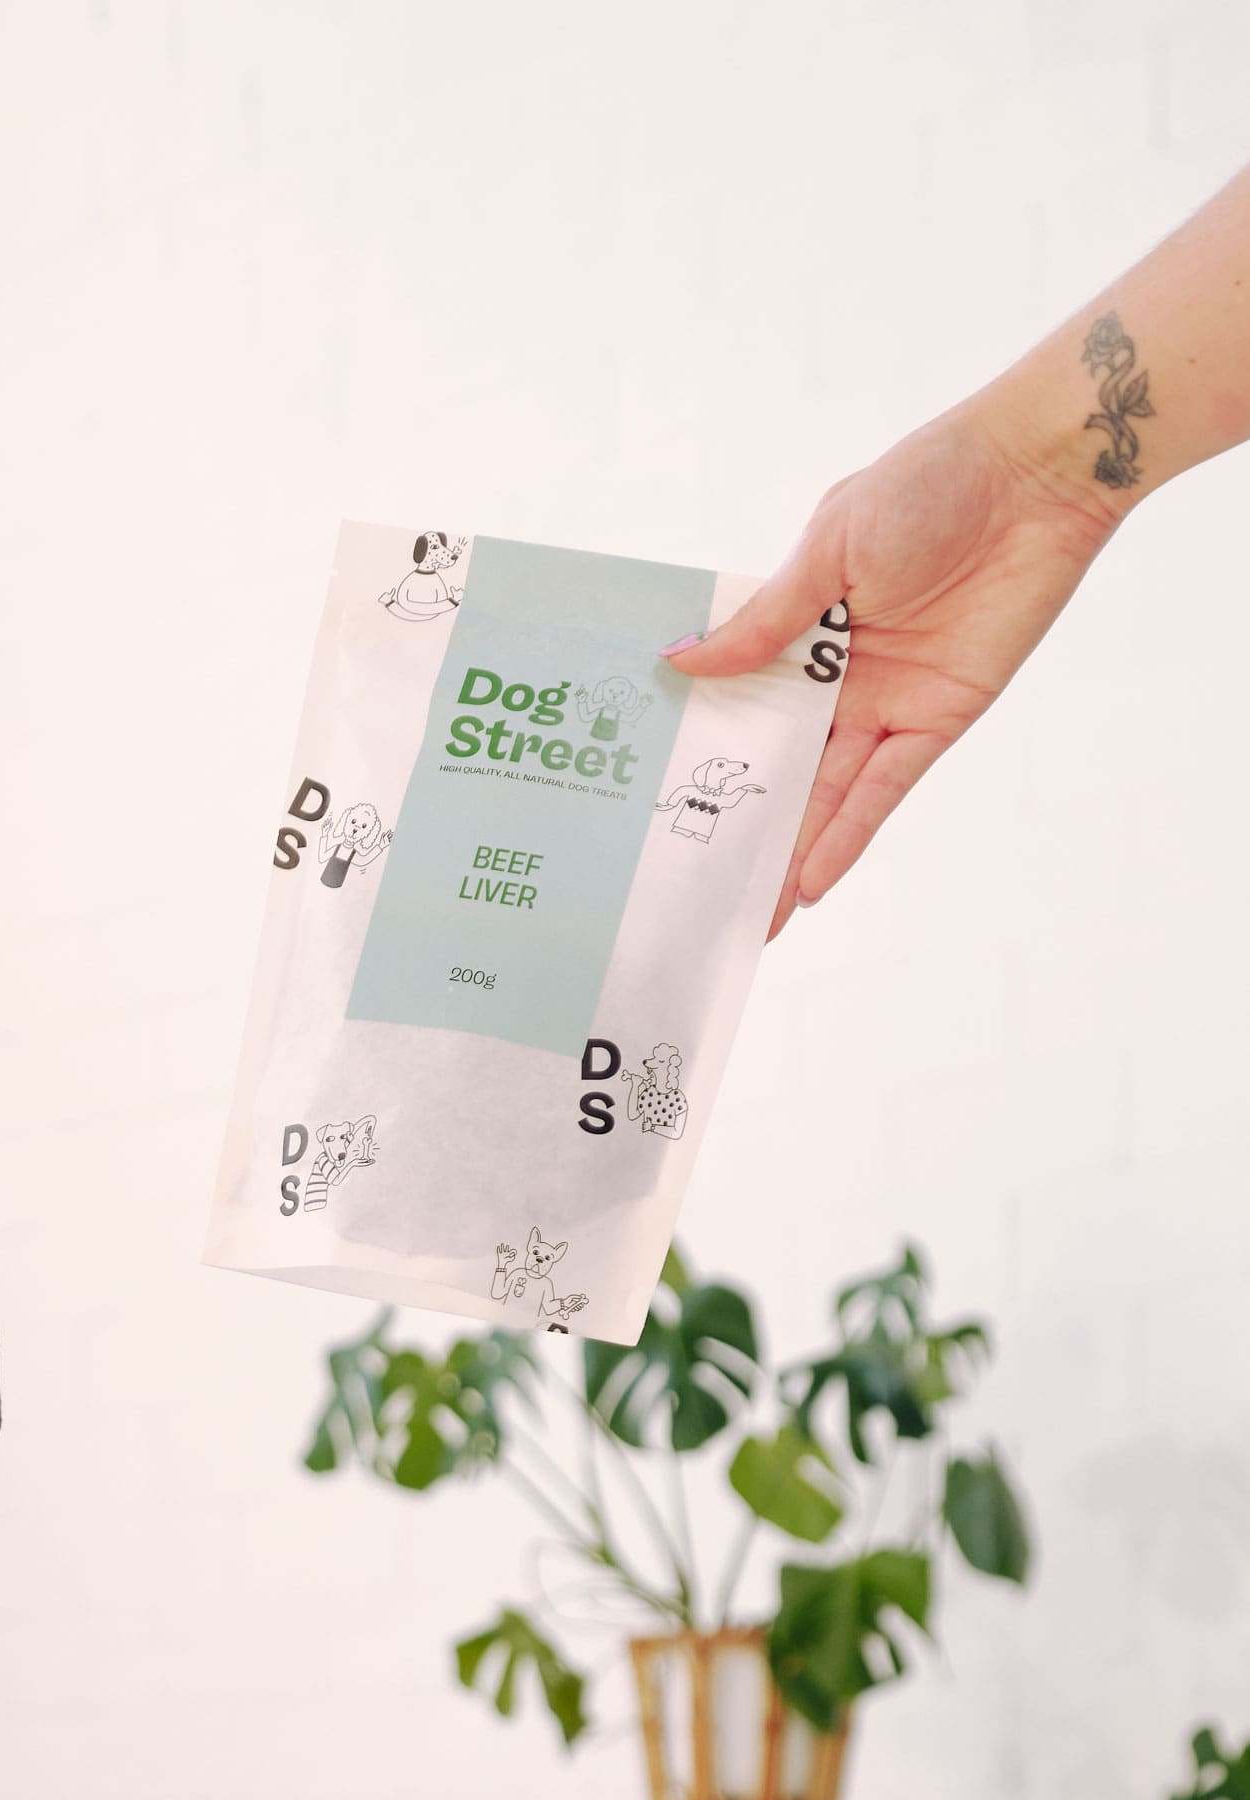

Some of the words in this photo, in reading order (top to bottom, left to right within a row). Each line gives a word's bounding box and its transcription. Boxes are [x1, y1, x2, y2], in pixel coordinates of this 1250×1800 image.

[803, 639, 847, 683] S
[456, 666, 572, 727] Dog
[445, 714, 639, 785] Street
[287, 776, 331, 822] D
[439, 764, 462, 774] HIGH
[503, 770, 521, 780] ALL
[523, 773, 567, 789] NATURAL
[568, 782, 590, 793] DOG
[273, 826, 307, 870] S
[472, 845, 544, 877] BEEF
[458, 875, 538, 910] LIVER
[449, 966, 498, 991] 200g
[581, 1038, 622, 1081] D
[578, 1091, 616, 1135] S
[282, 1123, 309, 1167] D
[279, 1174, 301, 1217] S
